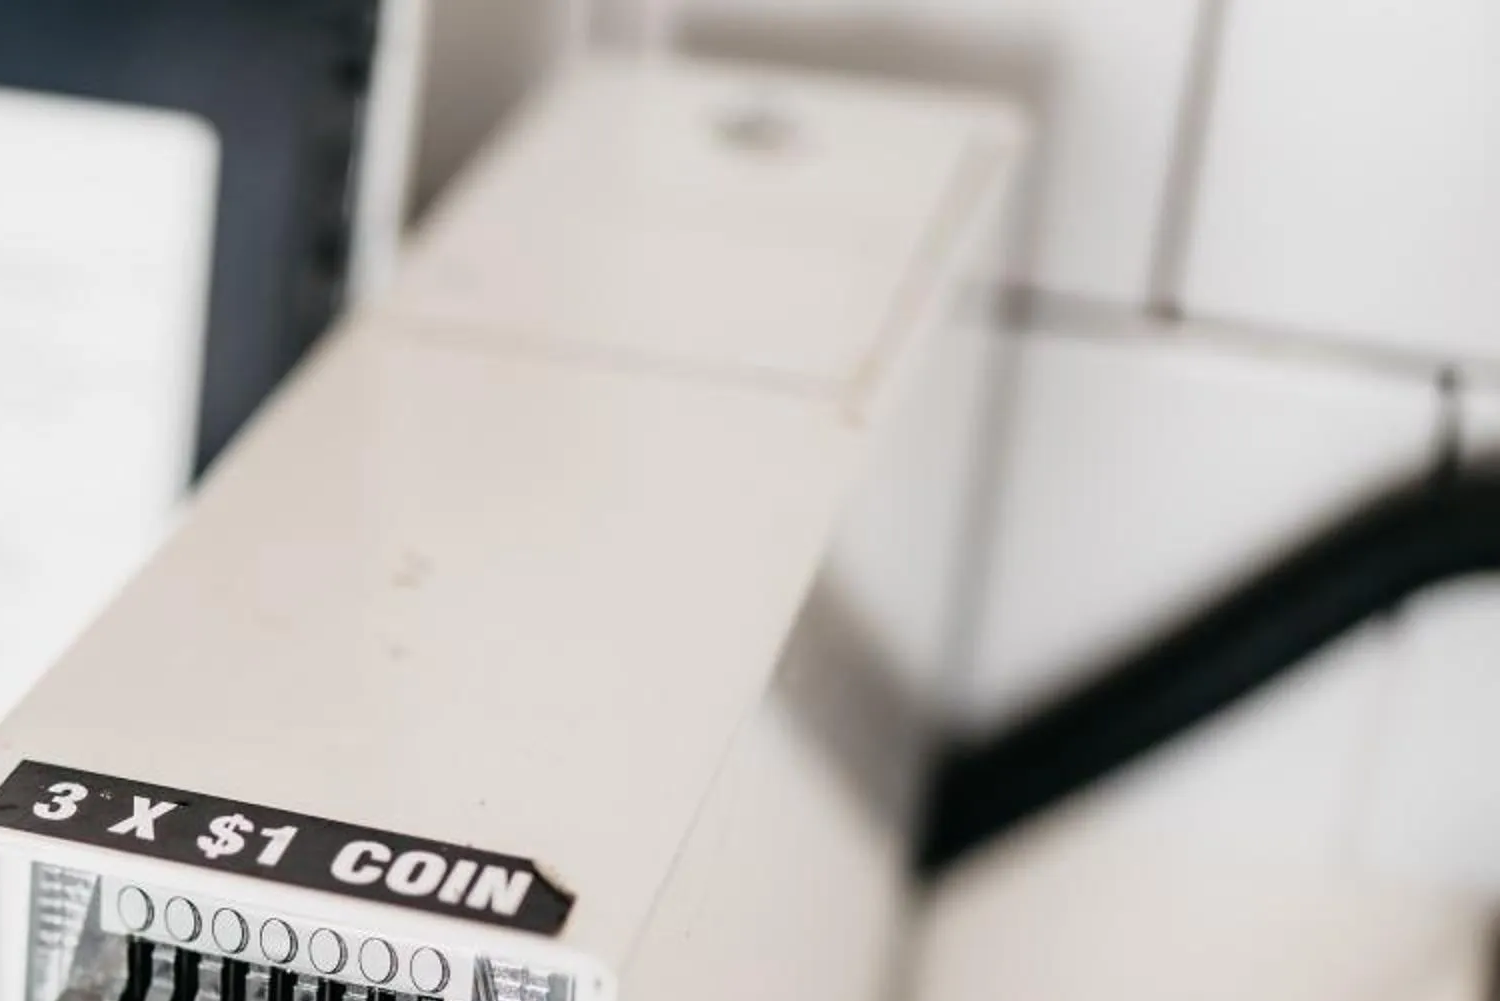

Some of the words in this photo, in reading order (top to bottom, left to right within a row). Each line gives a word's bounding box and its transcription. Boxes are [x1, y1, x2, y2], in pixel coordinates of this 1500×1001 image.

[32, 781, 89, 821] 3
[107, 796, 177, 840] X
[196, 813, 299, 867] $1
[330, 840, 533, 916] COIN
